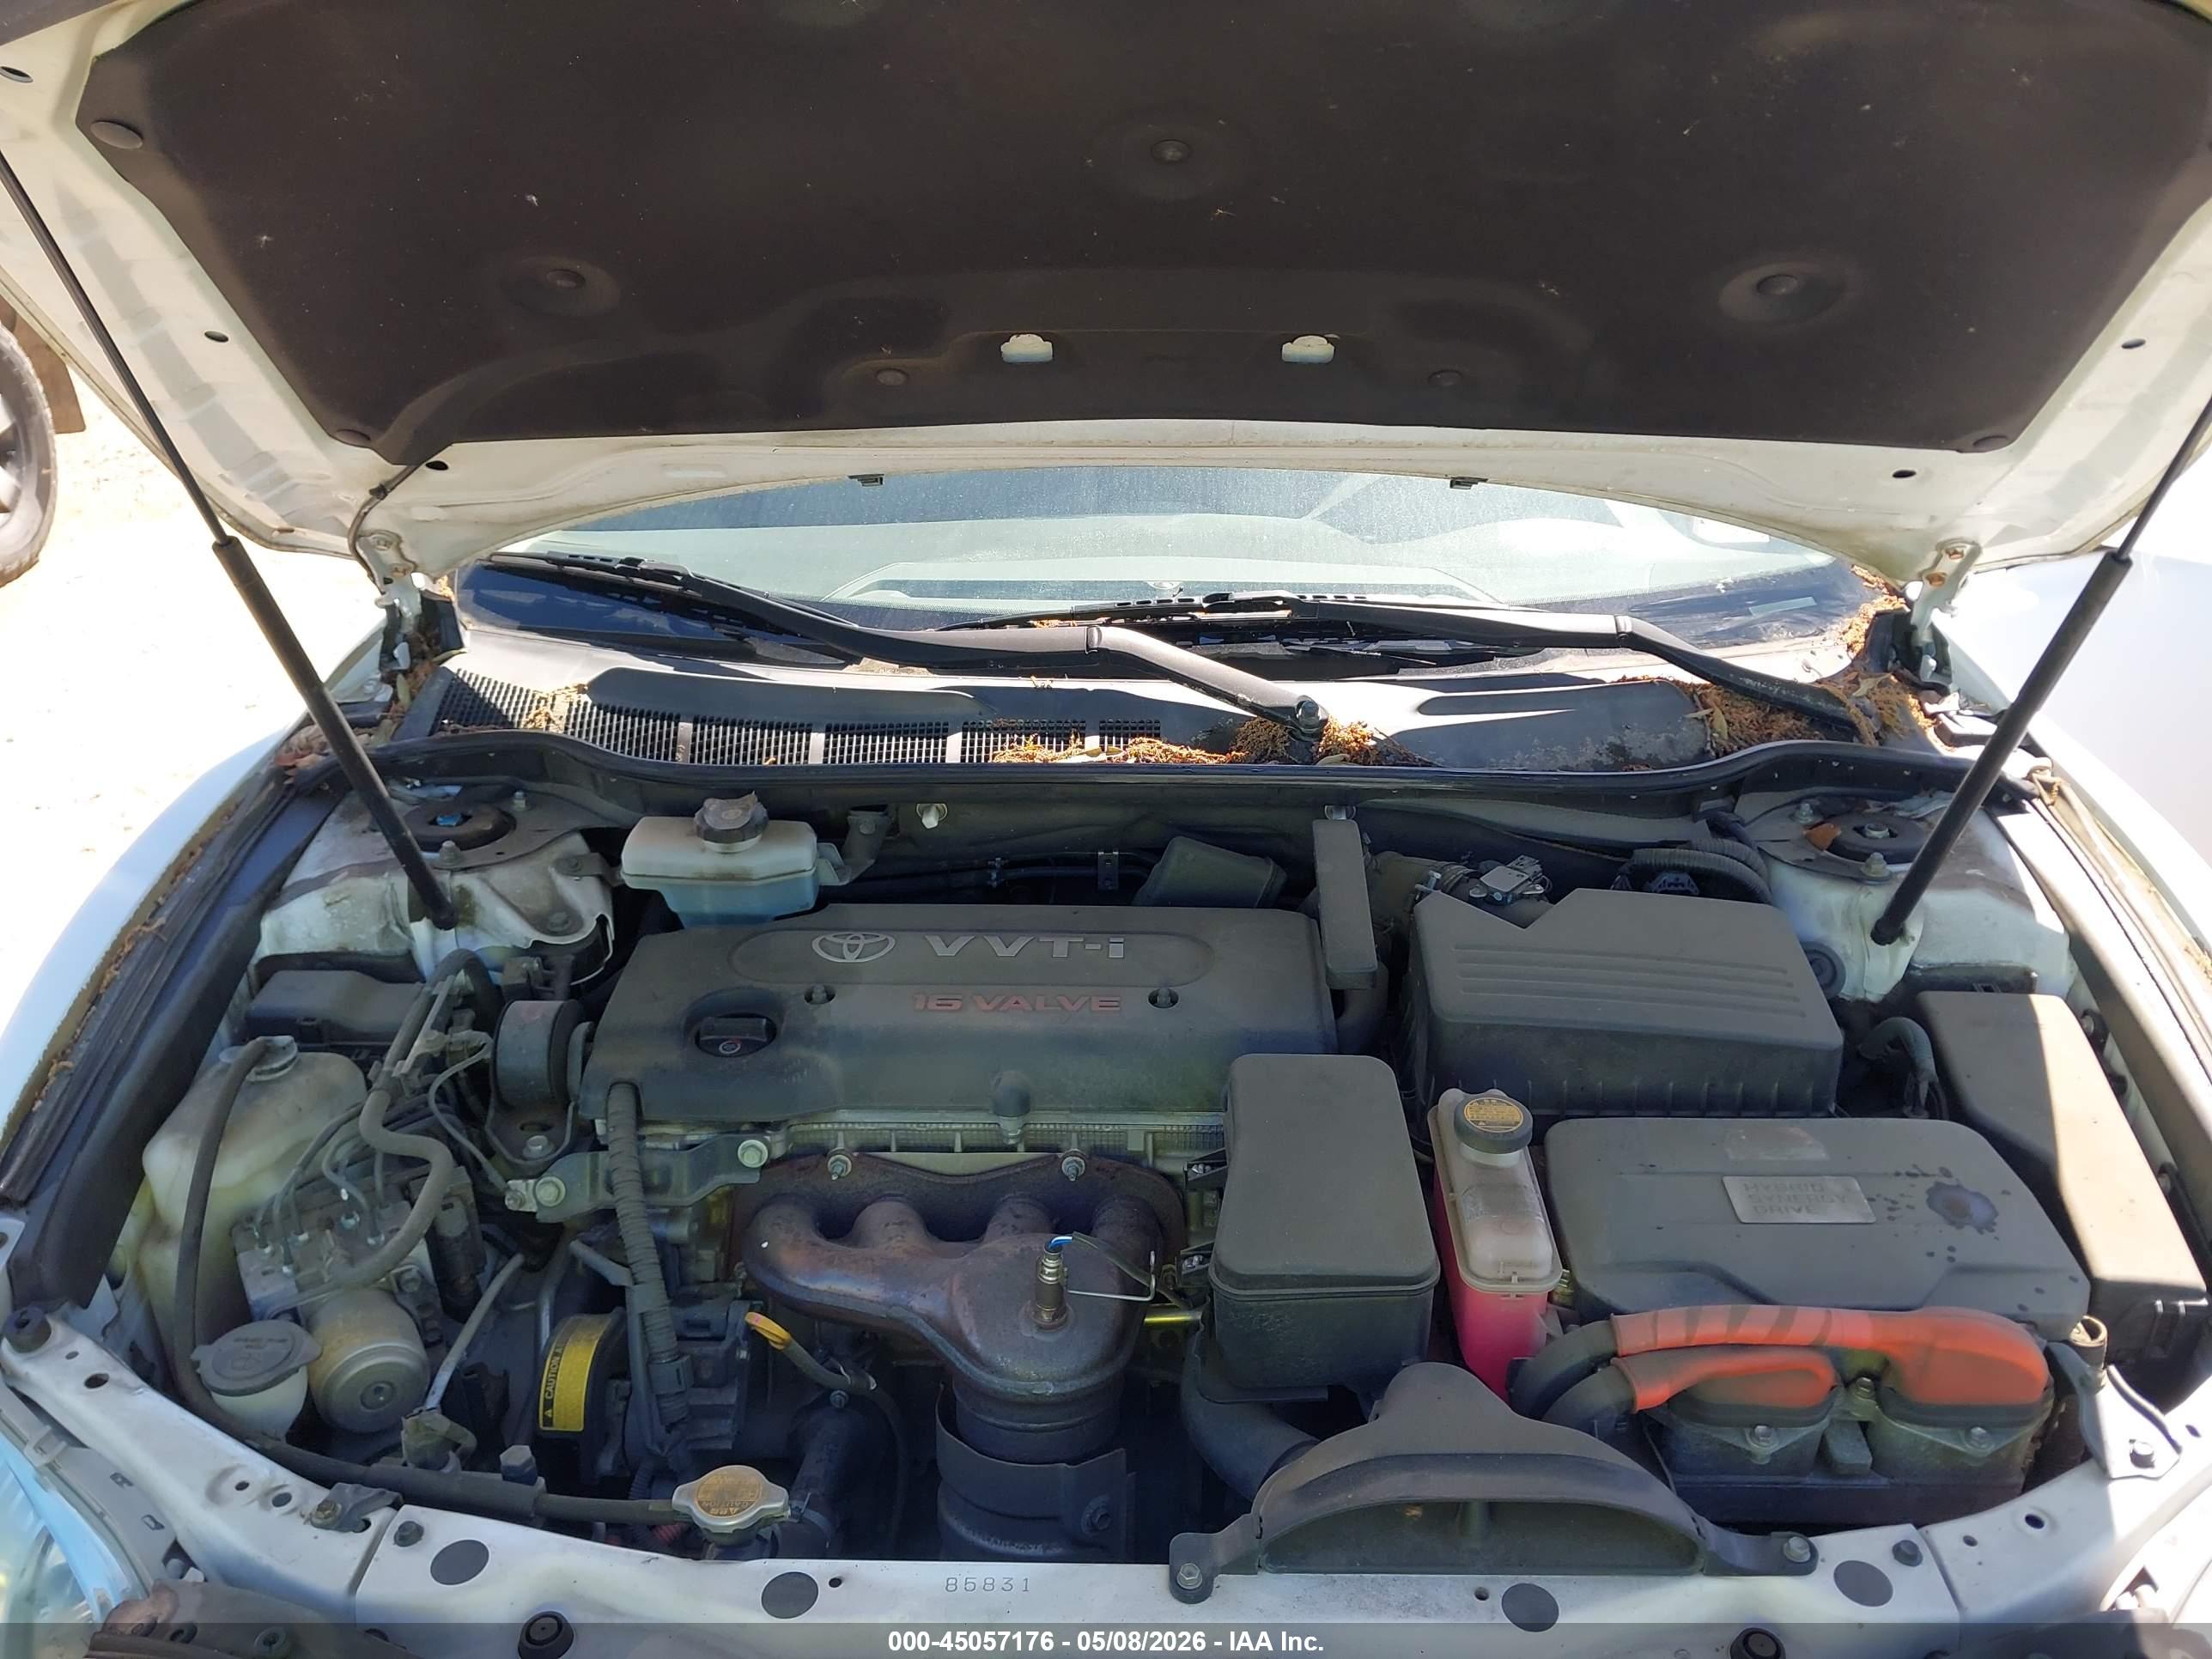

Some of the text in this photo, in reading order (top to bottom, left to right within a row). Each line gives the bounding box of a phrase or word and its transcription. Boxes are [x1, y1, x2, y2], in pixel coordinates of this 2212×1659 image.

[925, 934, 1125, 958] VVT-i
[913, 994, 1121, 1012] 16 VALVE
[1743, 1182, 1825, 1193] HYBRID
[1747, 1194, 1847, 1204] SYNERGY
[1753, 1205, 1816, 1215] DRIVE
[544, 1354, 561, 1400] CAUTION
[945, 1577, 1030, 1593] 85831
